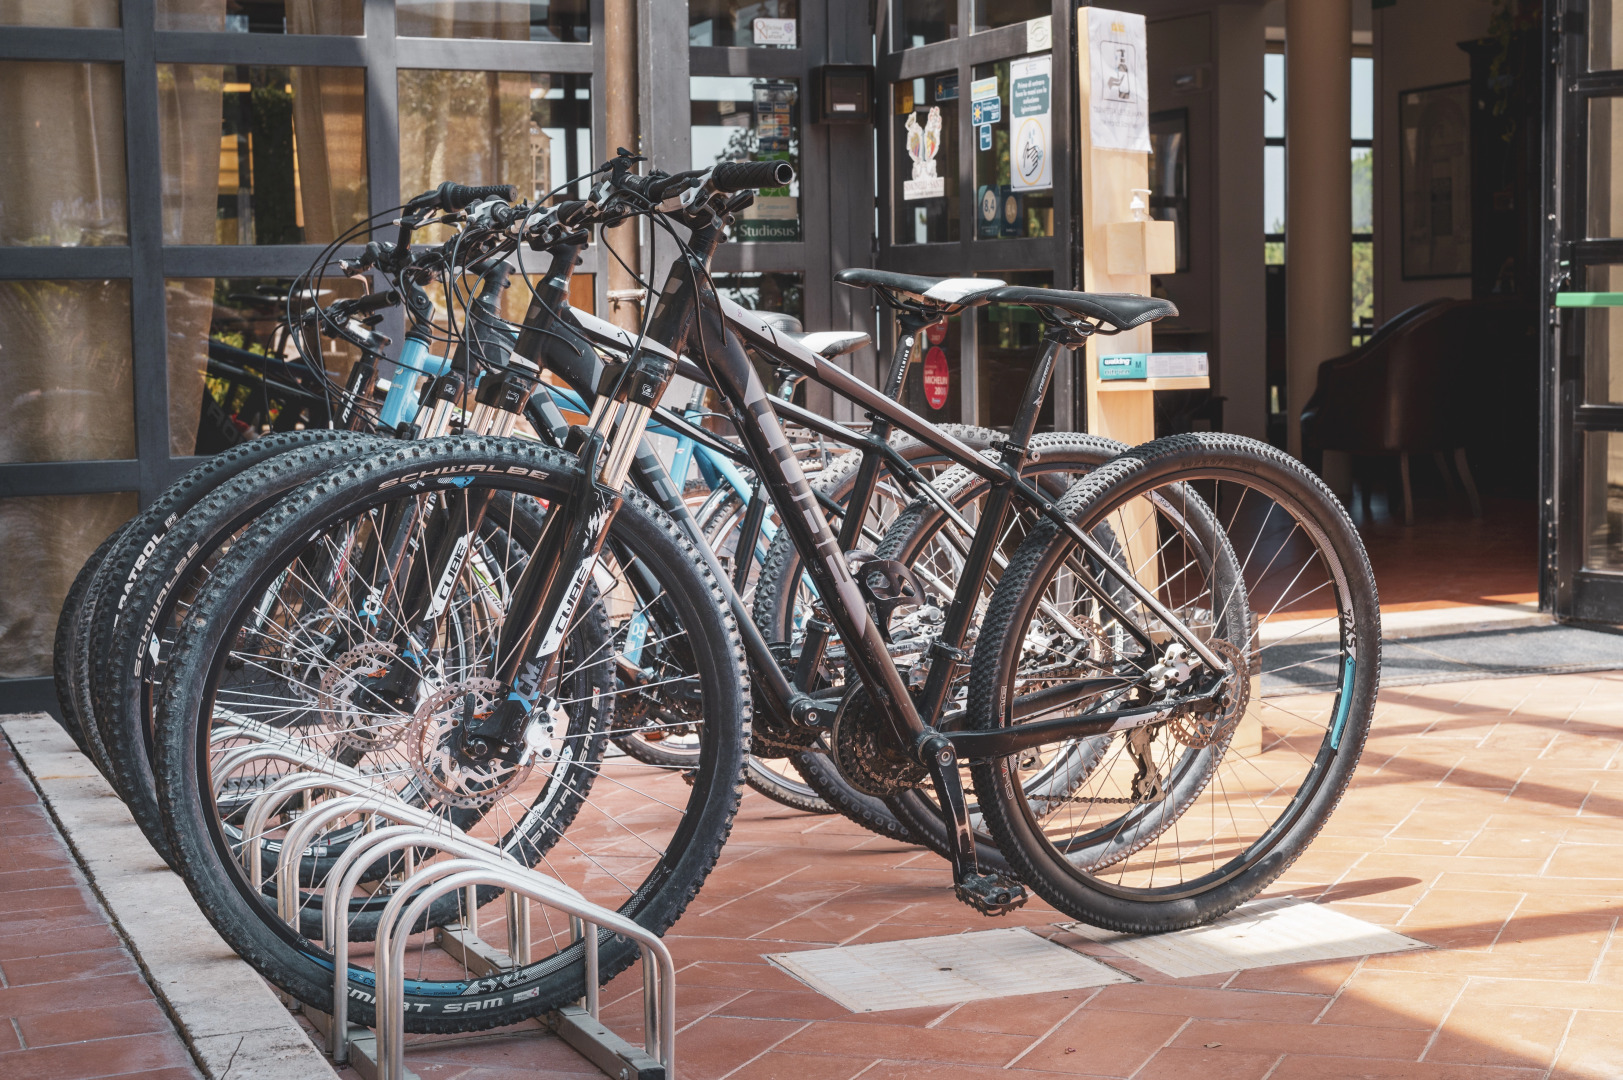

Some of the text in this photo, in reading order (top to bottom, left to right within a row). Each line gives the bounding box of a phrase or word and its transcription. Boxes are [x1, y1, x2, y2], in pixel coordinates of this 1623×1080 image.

[740, 224, 795, 237] Studiosus
[924, 376, 948, 385] MICHELIN
[378, 464, 550, 492] SCHWALBE
[165, 513, 178, 529] EPS
[439, 542, 468, 601] CUBE
[134, 542, 199, 677] SCHWALBE
[555, 566, 590, 635] CUBE
[631, 622, 646, 639] 03
[531, 716, 597, 846] SMART SAM
[442, 997, 504, 1014] SAM
